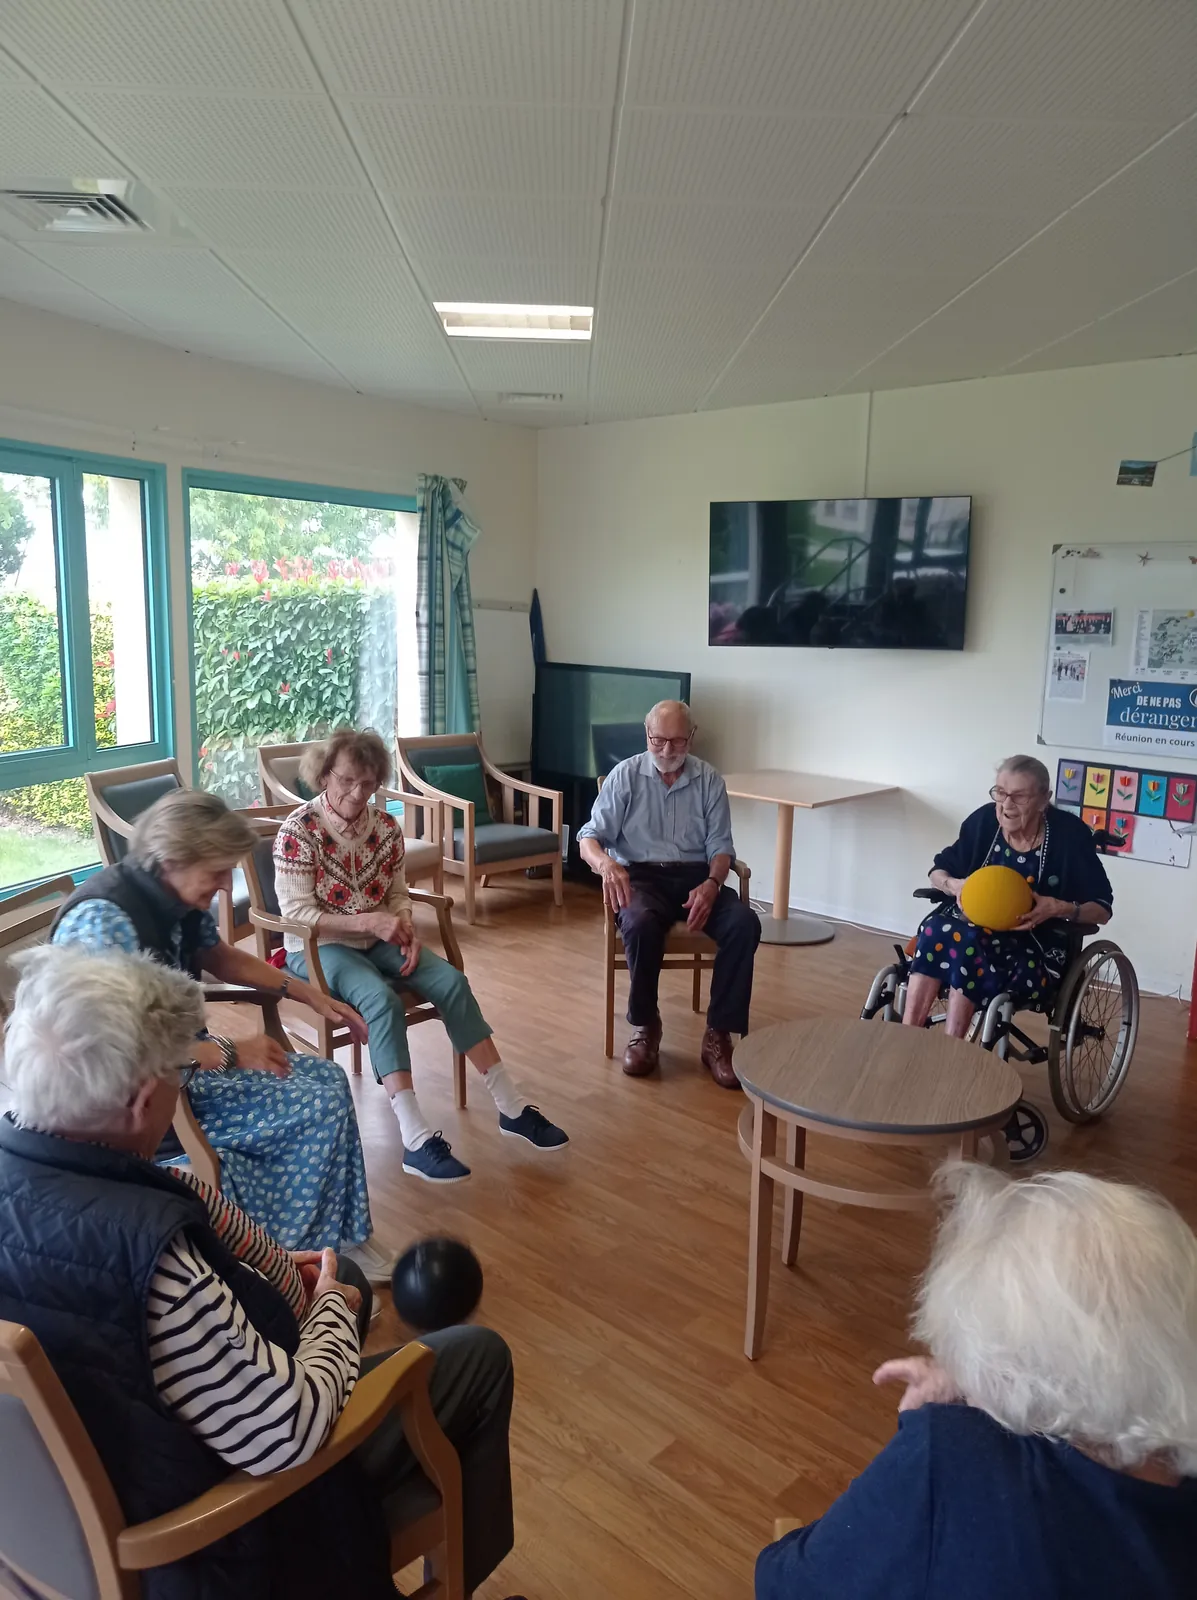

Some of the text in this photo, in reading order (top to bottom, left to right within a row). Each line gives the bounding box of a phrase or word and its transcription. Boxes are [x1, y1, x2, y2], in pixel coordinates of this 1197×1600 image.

[1111, 682, 1143, 699] Merci
[1137, 695, 1182, 708] DE NE PAS
[1120, 707, 1197, 730] déranger
[1115, 732, 1153, 743] Réunion
[1170, 739, 1195, 747] cours
